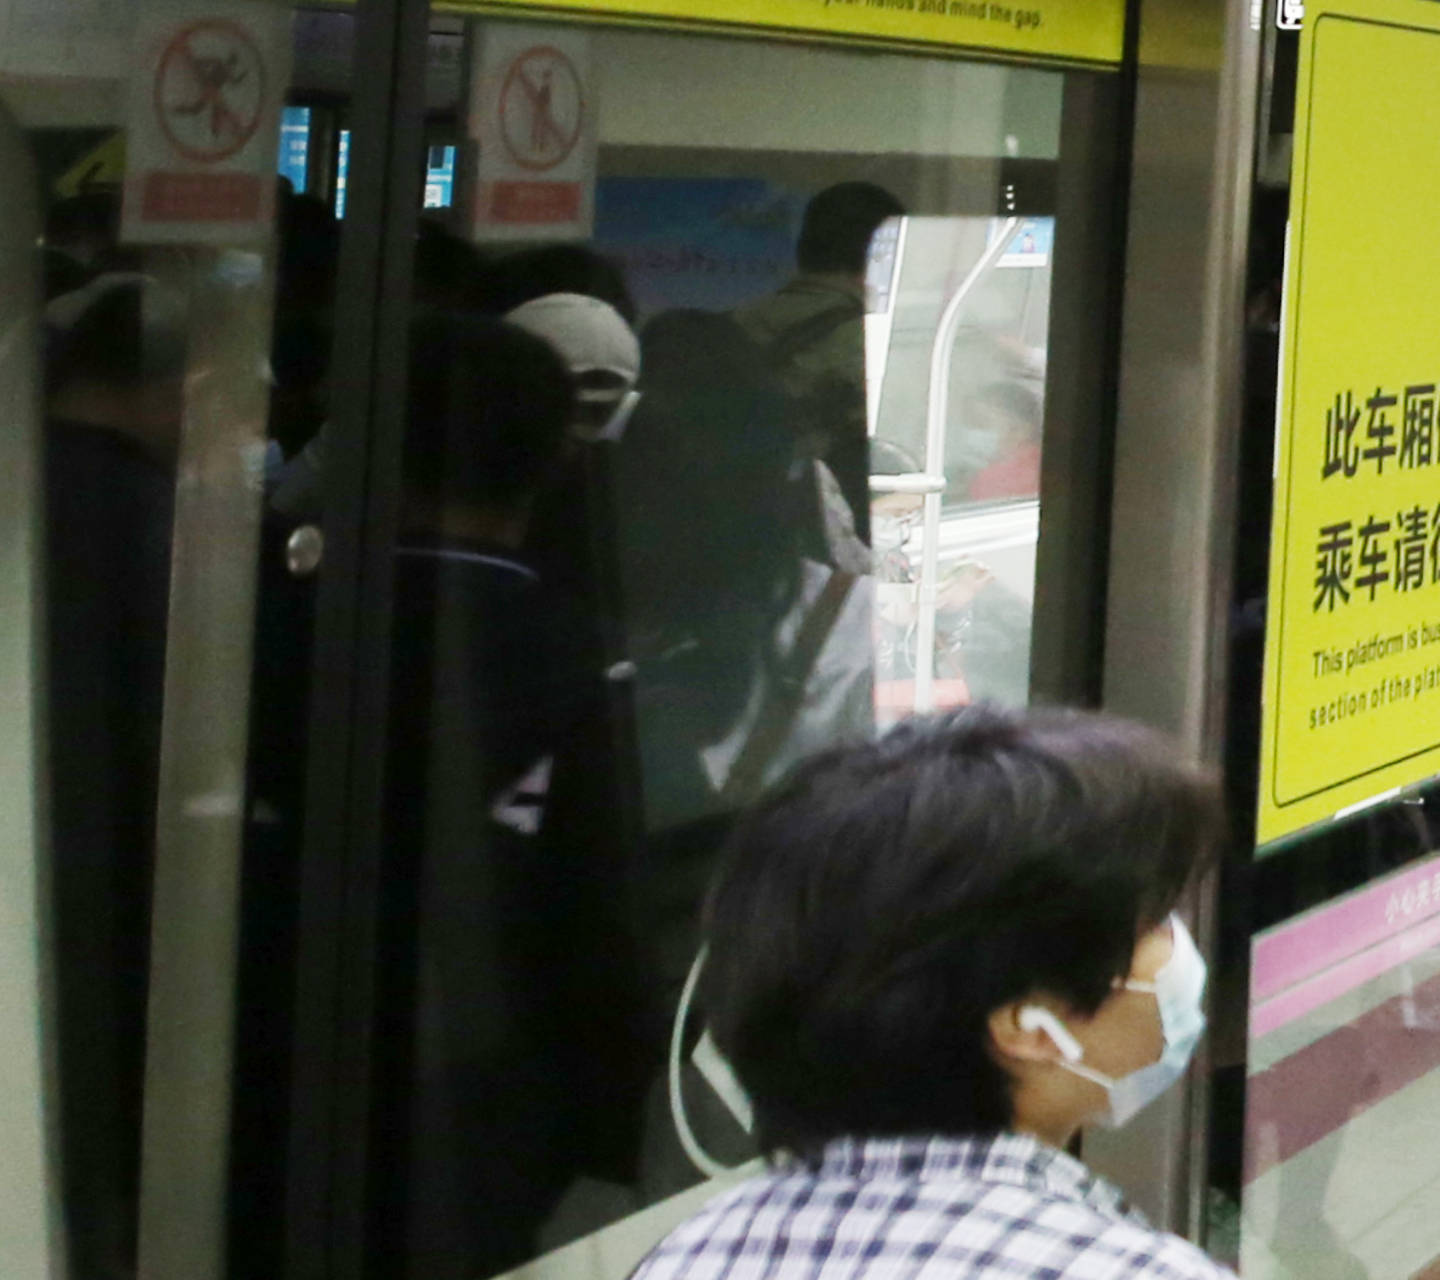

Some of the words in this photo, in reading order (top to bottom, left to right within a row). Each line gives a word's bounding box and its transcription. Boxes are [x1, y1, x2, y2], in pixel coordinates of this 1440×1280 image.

[950, 0, 986, 20] mind
[990, 3, 1011, 22] the
[1314, 650, 1343, 679] This
[1345, 633, 1403, 676] platform
[1406, 626, 1418, 649] is
[1310, 692, 1367, 730] section
[1371, 678, 1386, 708] of
[1387, 674, 1411, 701] the
